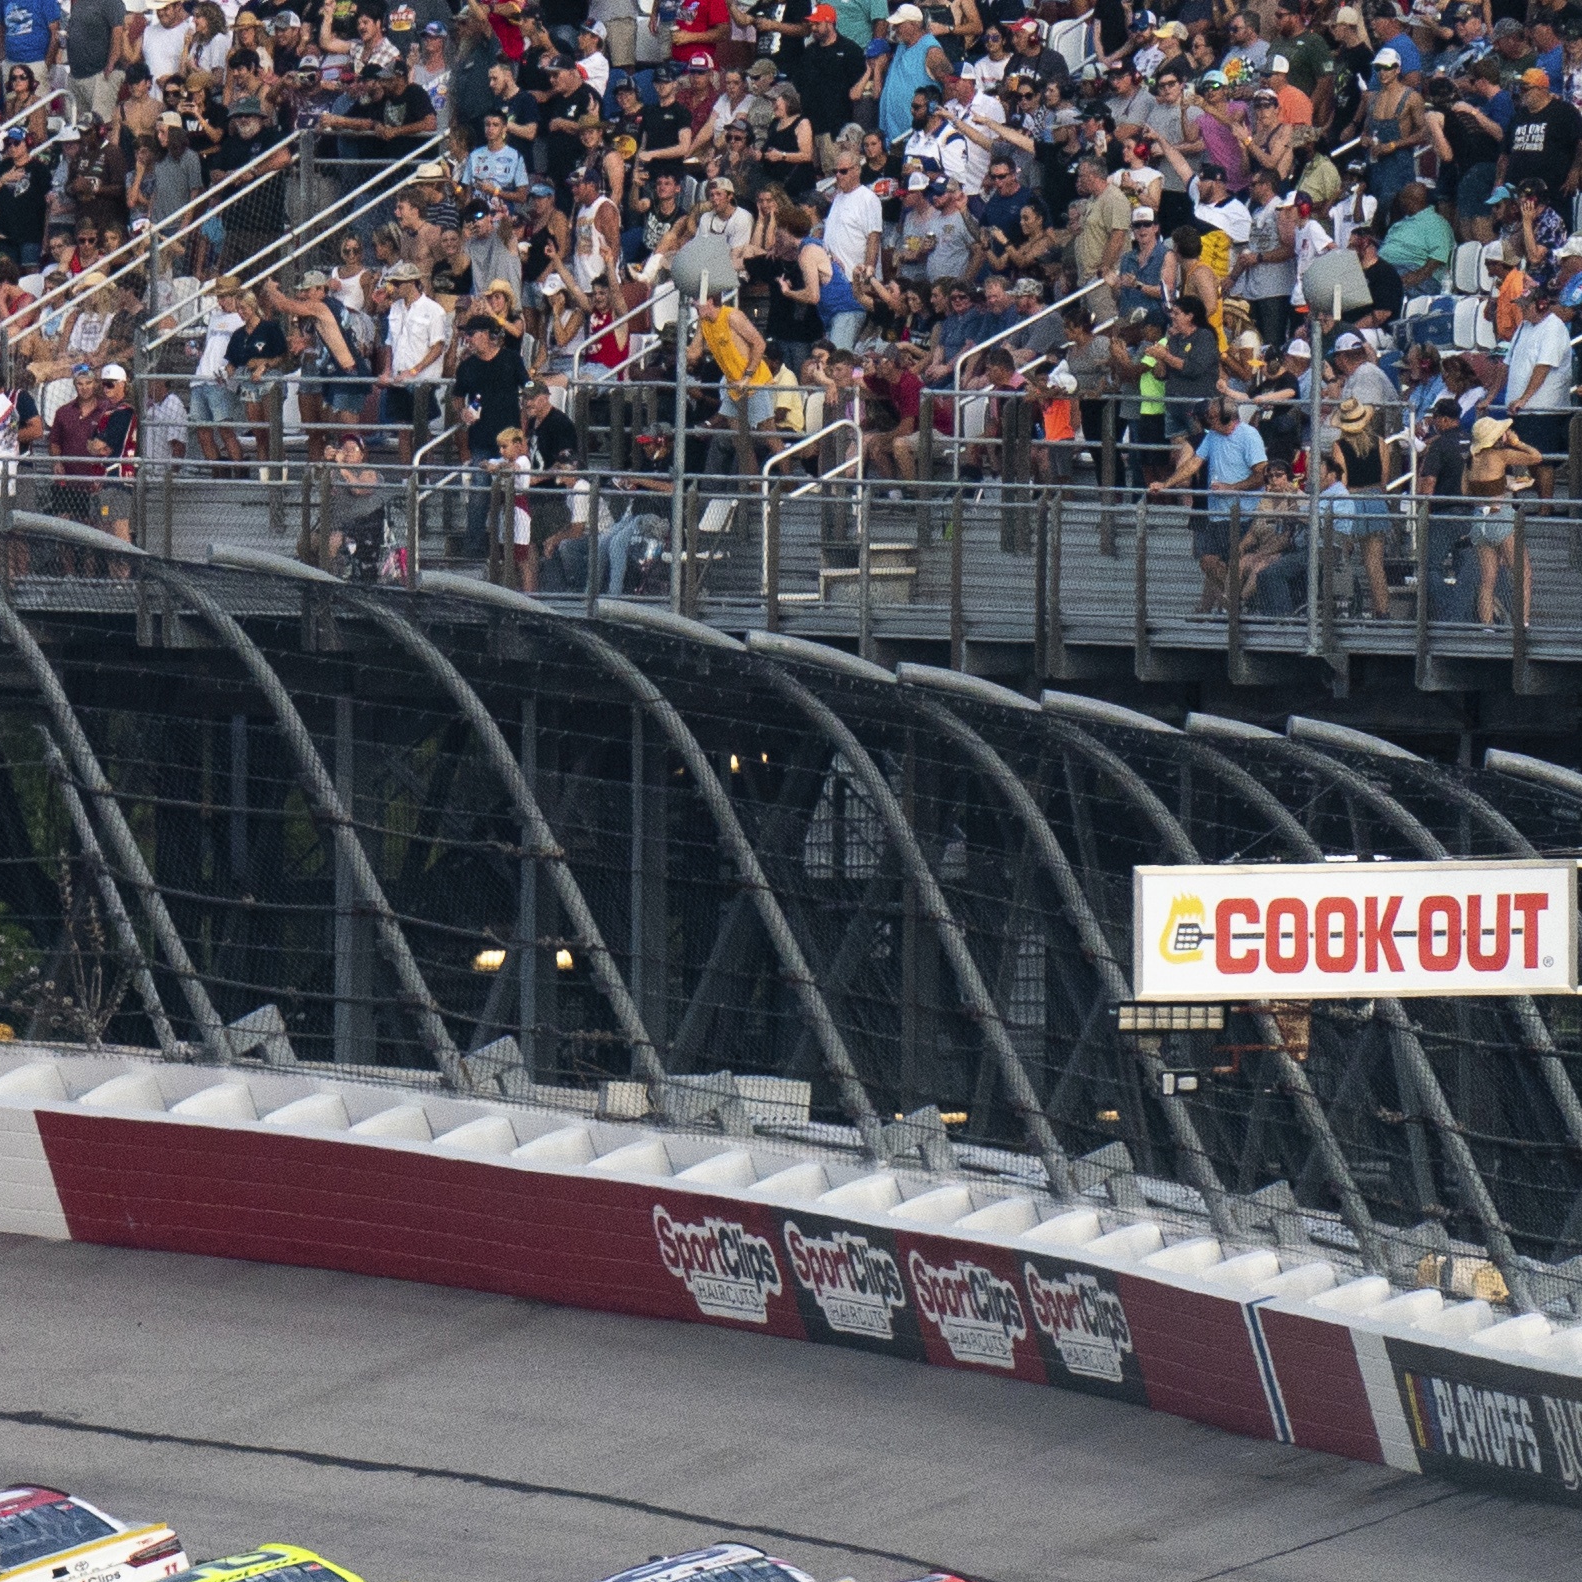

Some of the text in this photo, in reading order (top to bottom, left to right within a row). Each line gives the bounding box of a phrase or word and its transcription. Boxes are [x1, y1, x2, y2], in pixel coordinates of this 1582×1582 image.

[1215, 892, 1550, 975] COOK OUT
[695, 1280, 758, 1309] HAIRCUTS
[830, 1303, 887, 1327] HAIRCUTS
[951, 1330, 1011, 1356] HAIRCUTS
[1431, 1376, 1543, 1474] PLAYOFFS
